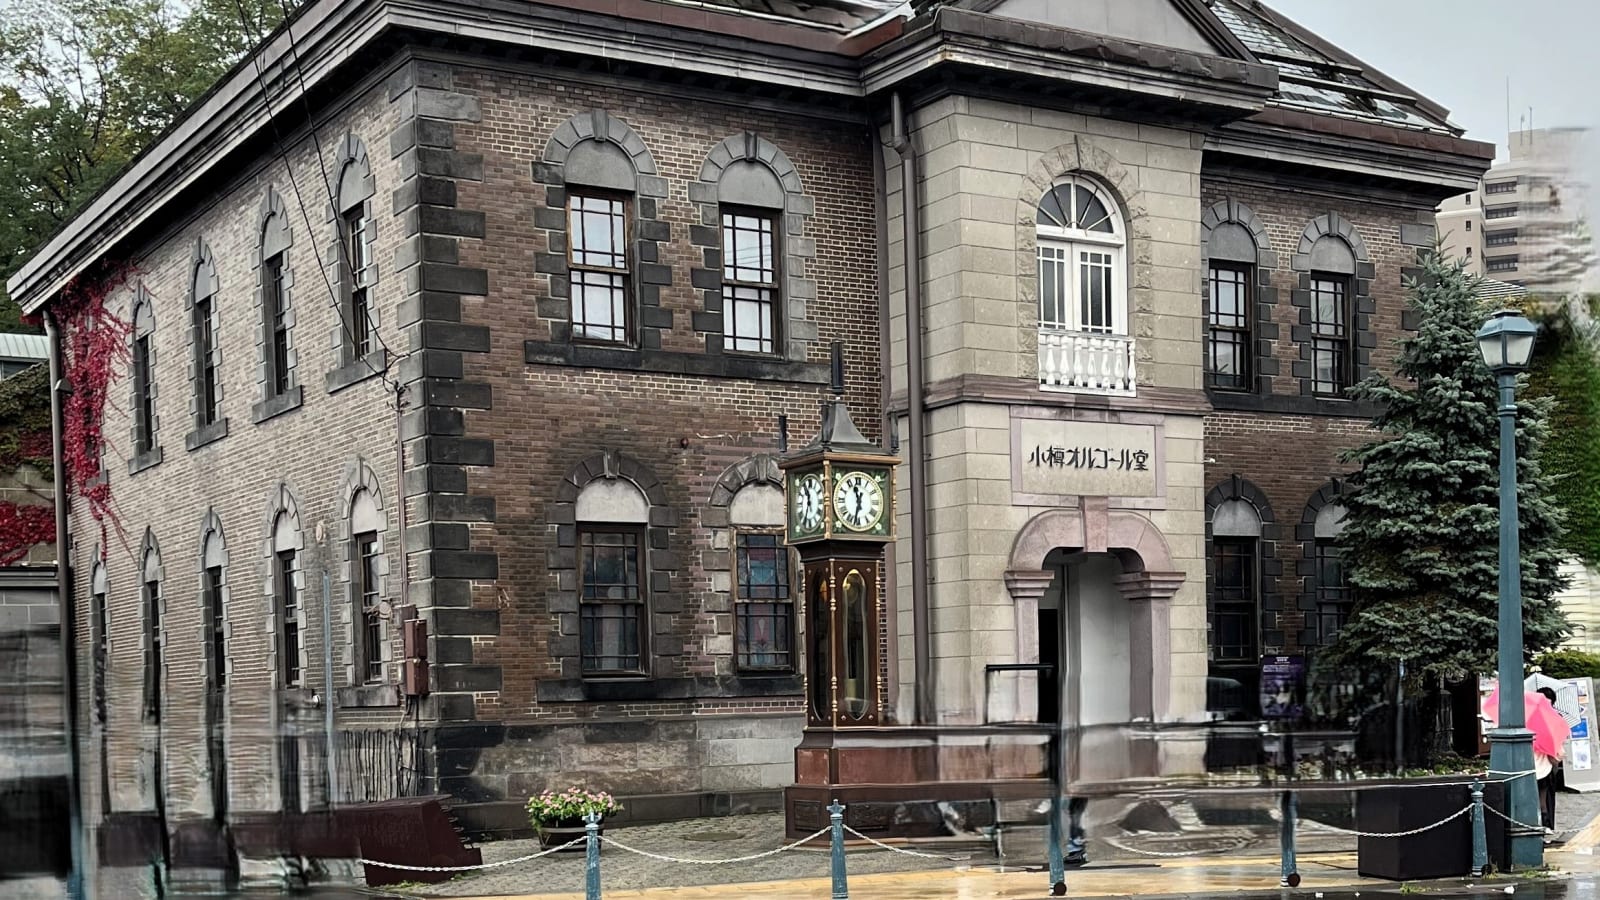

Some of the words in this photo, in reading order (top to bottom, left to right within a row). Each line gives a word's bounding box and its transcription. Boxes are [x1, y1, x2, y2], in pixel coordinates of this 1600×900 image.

[1028, 445, 1149, 471] 小樽オルゴール堂
